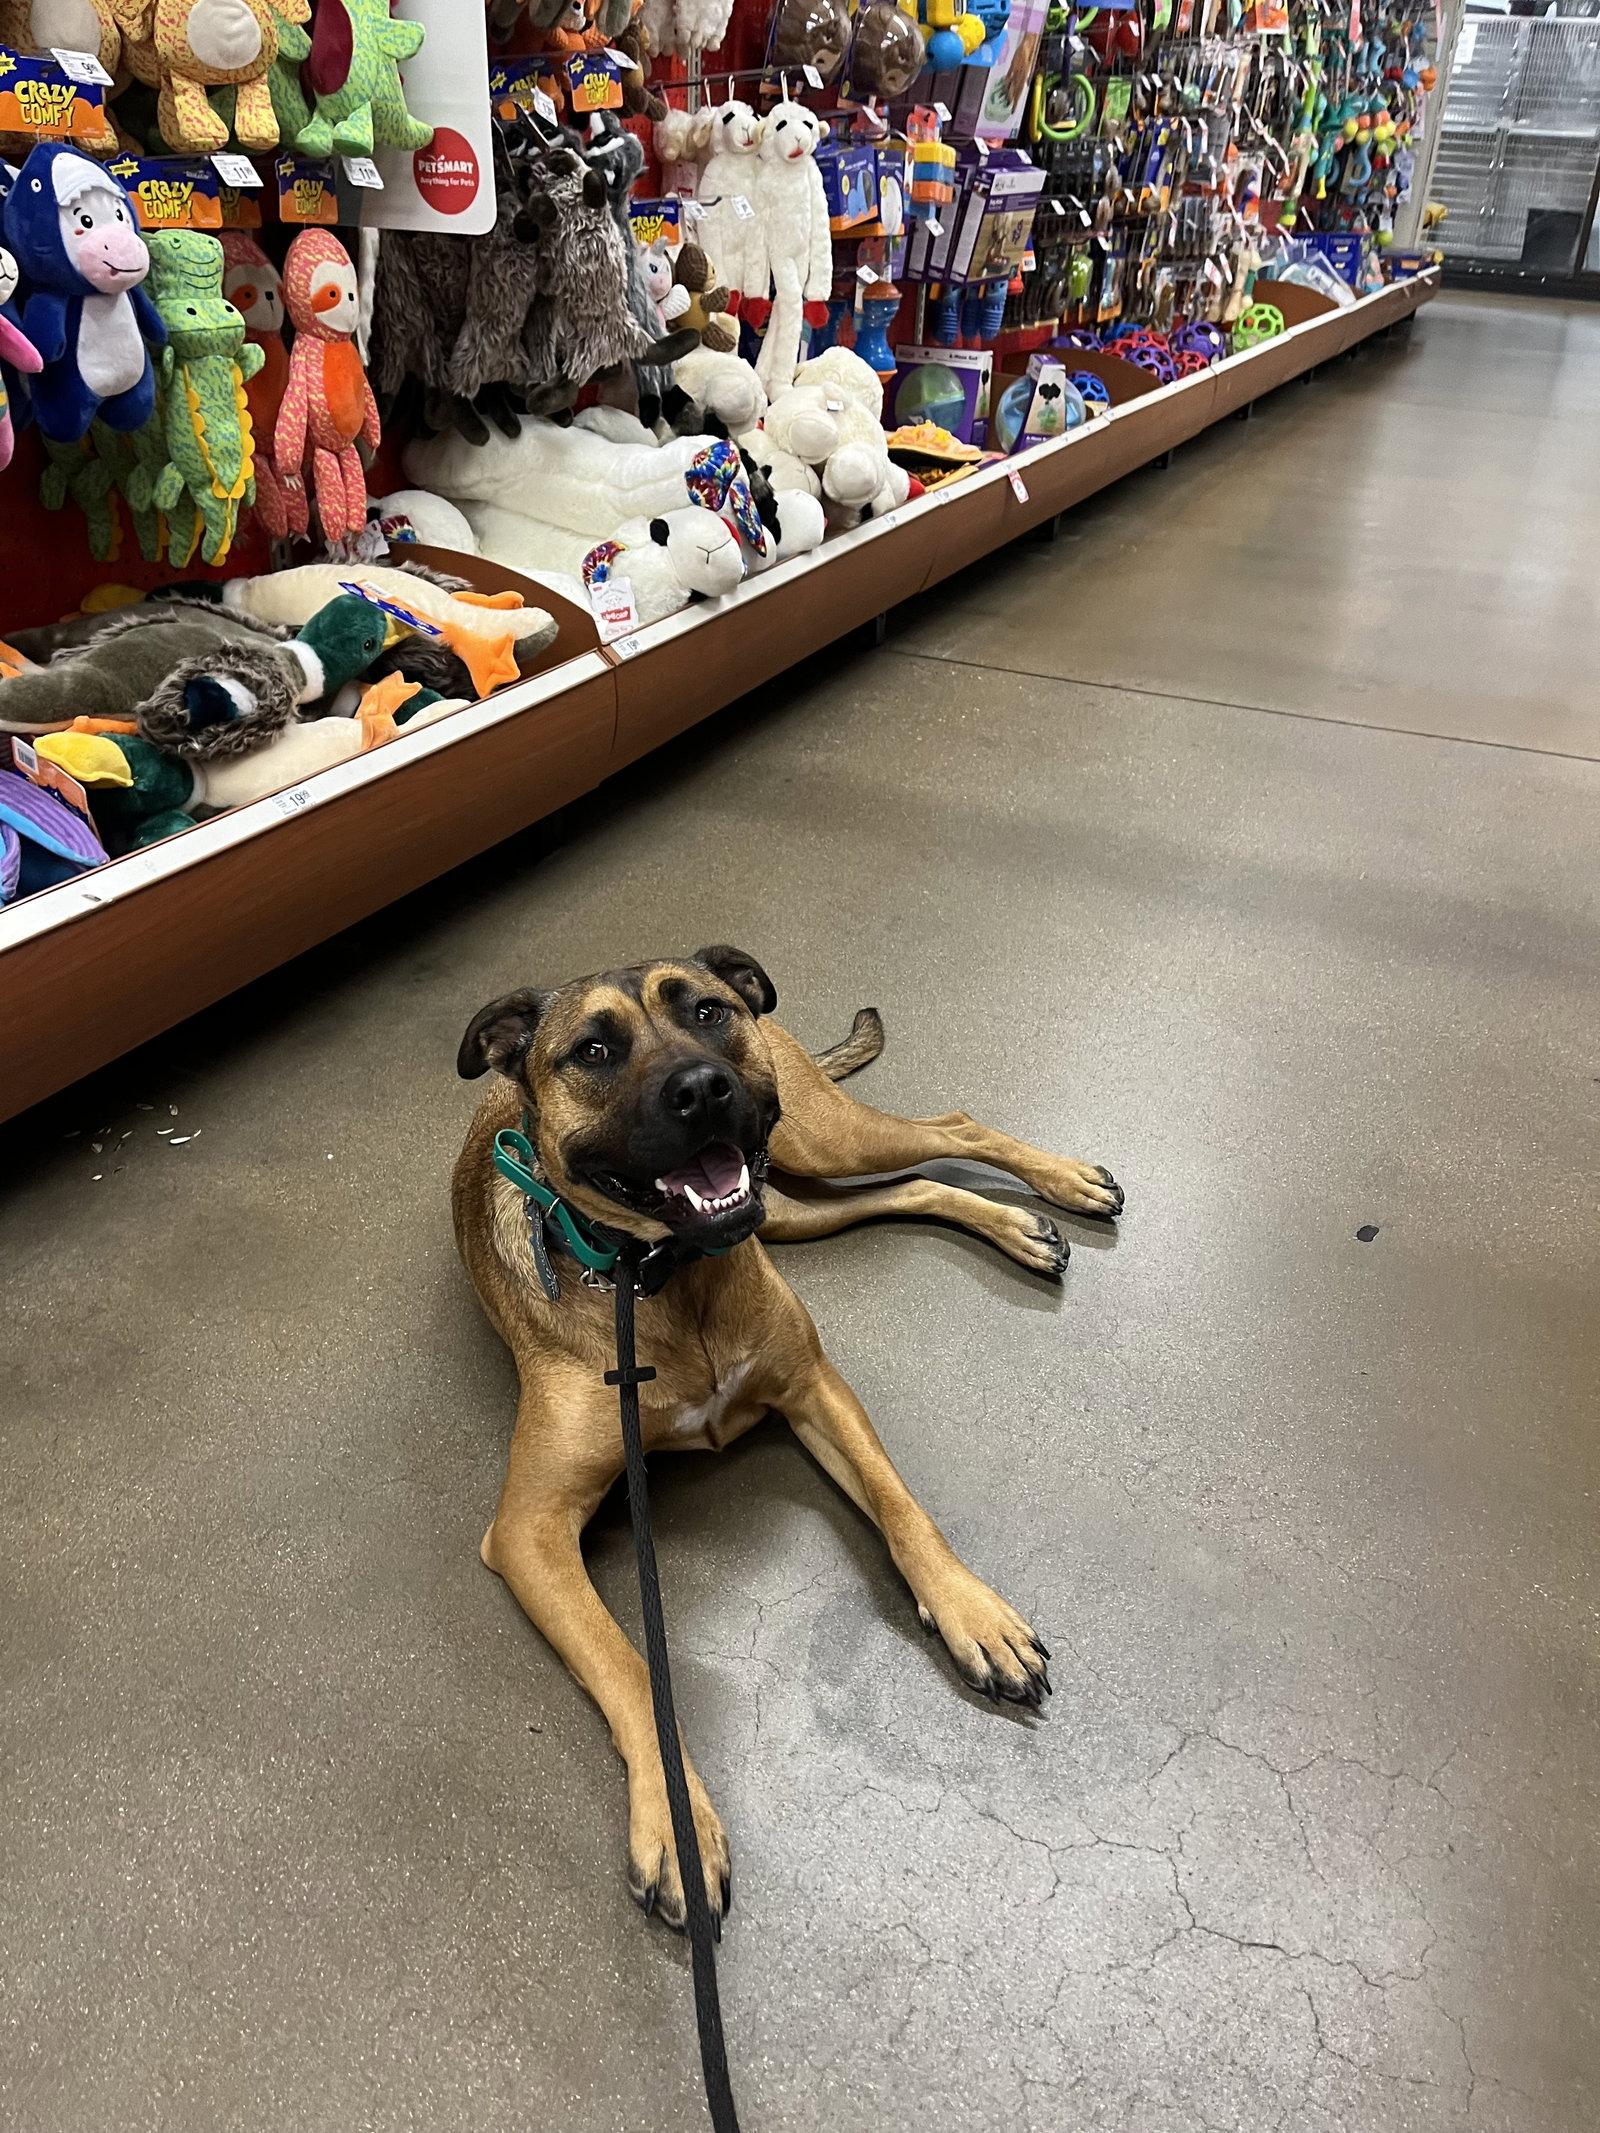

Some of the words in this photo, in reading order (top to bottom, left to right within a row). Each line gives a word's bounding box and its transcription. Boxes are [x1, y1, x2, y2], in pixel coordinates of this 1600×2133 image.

[21, 102, 75, 128] COMFY
[418, 159, 473, 174] PETSMART
[420, 177, 449, 187] Anything
[450, 177, 460, 186] for
[460, 178, 475, 187] Pets
[143, 199, 193, 220] COMFY
